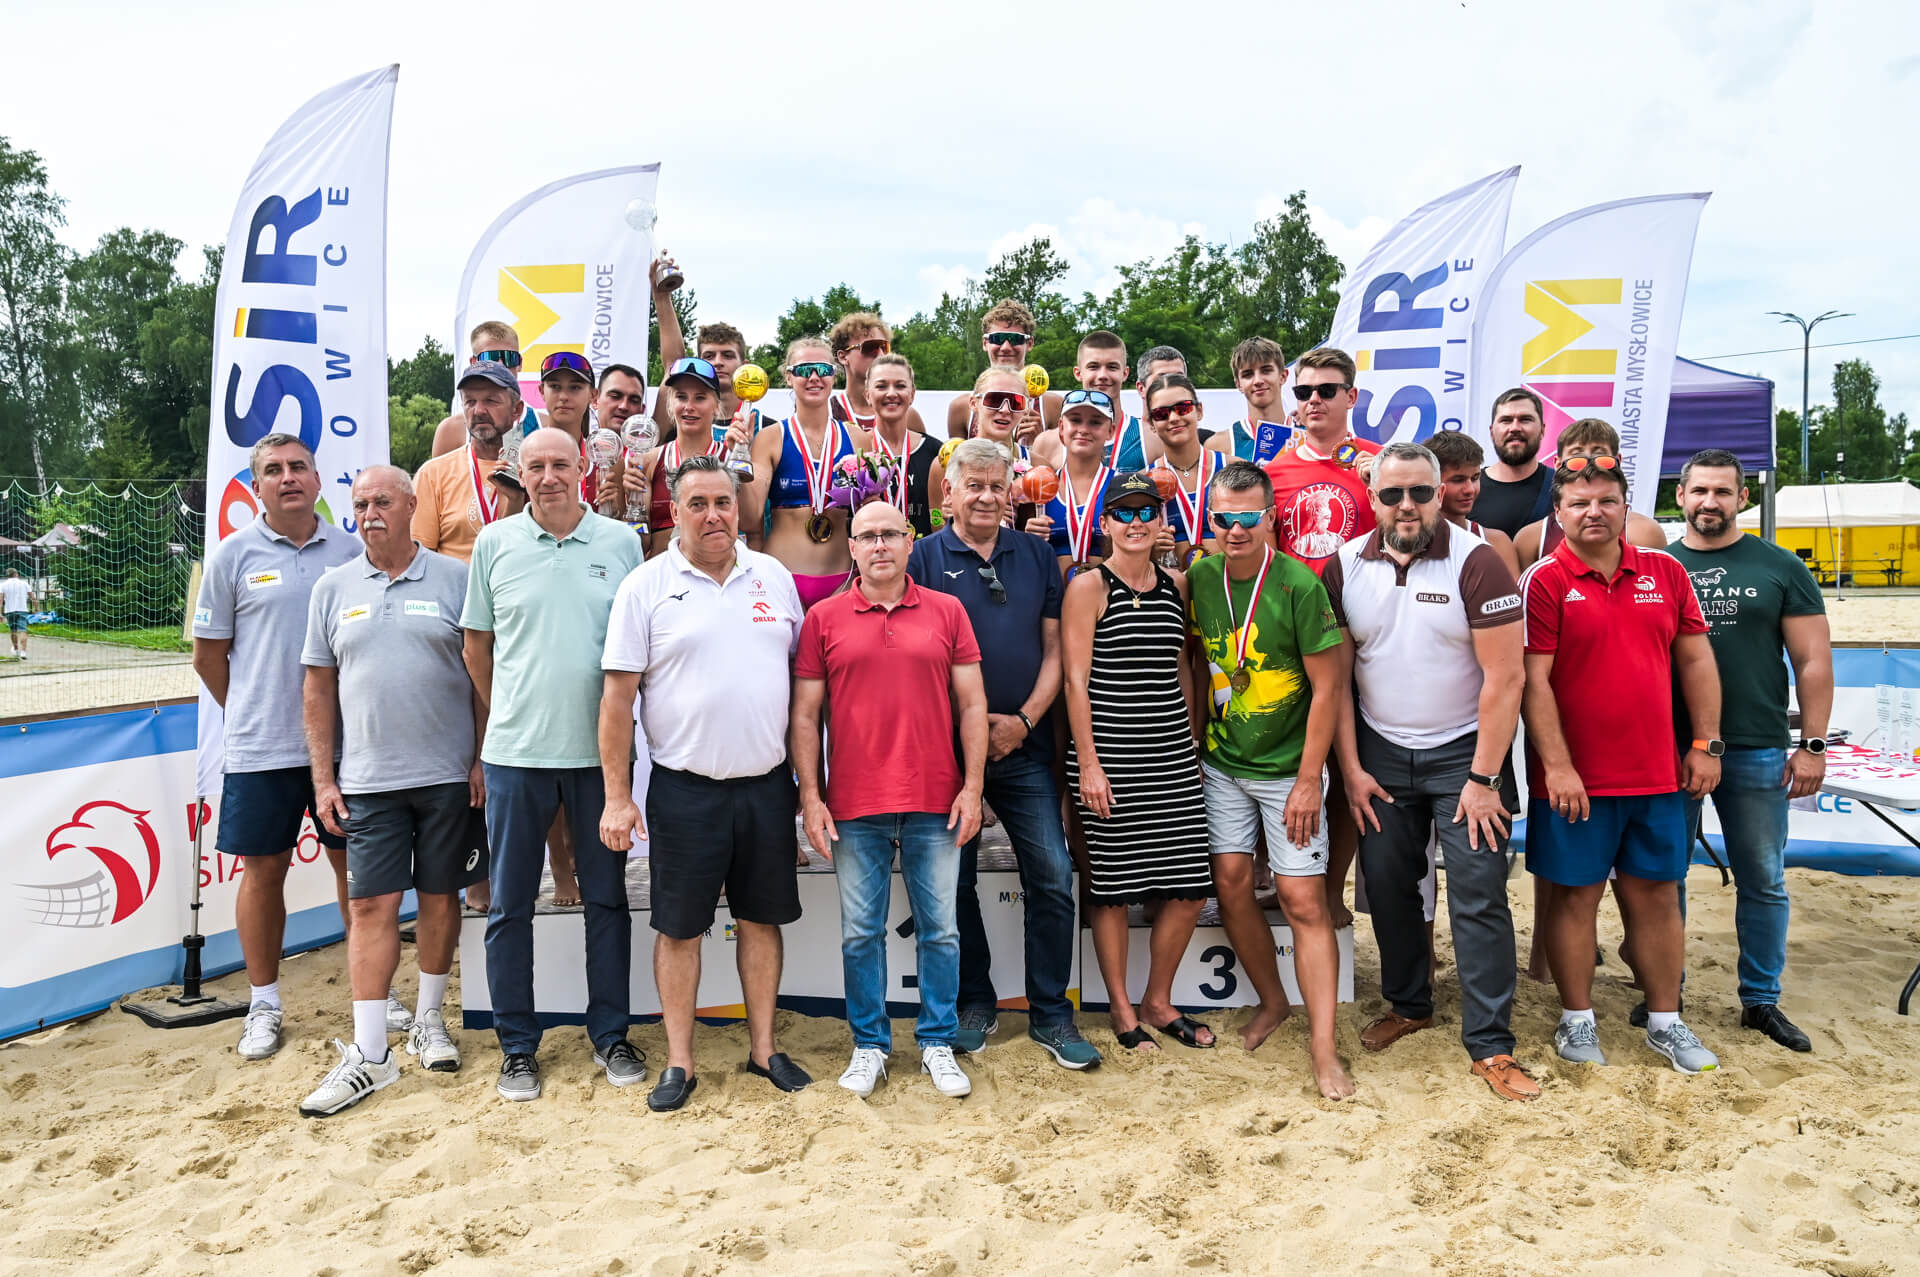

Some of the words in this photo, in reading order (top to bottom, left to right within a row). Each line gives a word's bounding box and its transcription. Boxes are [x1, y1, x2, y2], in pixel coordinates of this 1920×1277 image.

[1625, 279, 1654, 382] MYSŁOWICE
[1620, 386, 1643, 449] MIASTA
[1417, 593, 1448, 603] BRAKS
[1485, 596, 1521, 612] BRAKS
[1694, 587, 1758, 598] TANG
[1199, 945, 1237, 1001] 3
